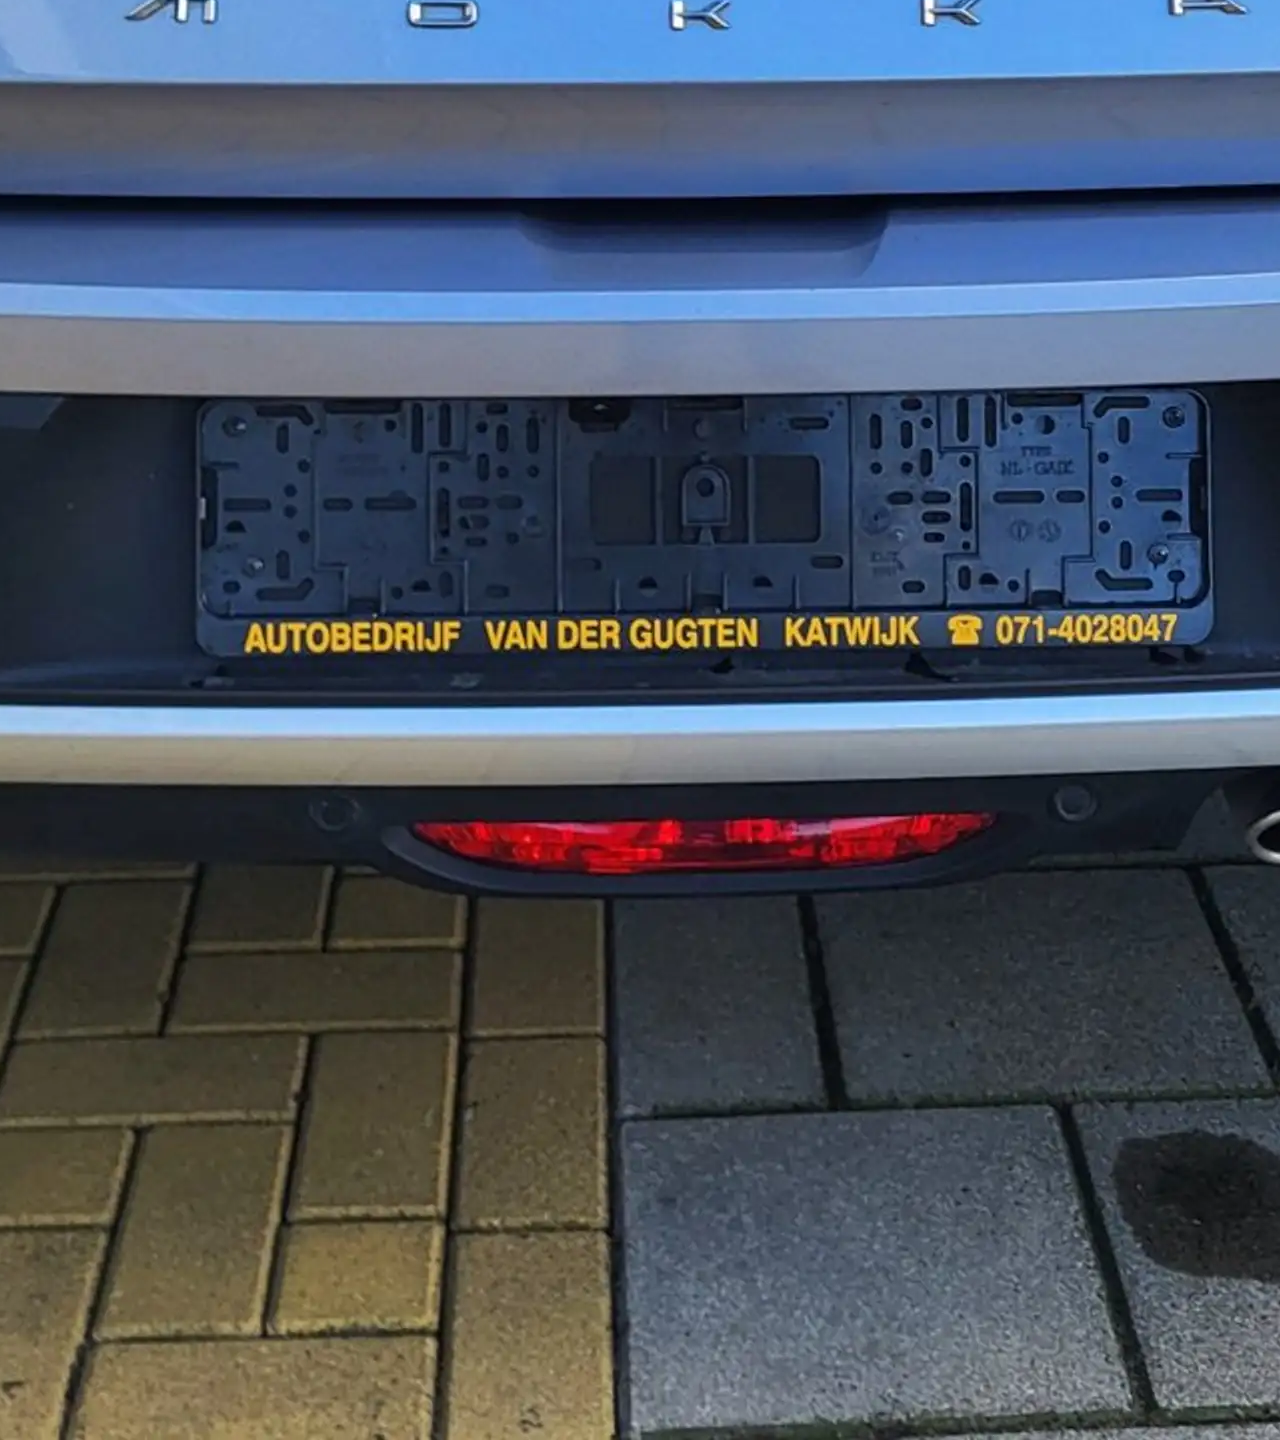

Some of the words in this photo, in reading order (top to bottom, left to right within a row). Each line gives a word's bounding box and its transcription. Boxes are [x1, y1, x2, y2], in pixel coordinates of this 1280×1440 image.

[244, 621, 461, 654] AUTOBEDRIJF
[484, 620, 548, 651] VAN
[557, 619, 621, 650] DER
[629, 616, 759, 650] GUGTEN
[784, 616, 921, 647] KATWIJK
[995, 613, 1179, 644] 071-4028047
